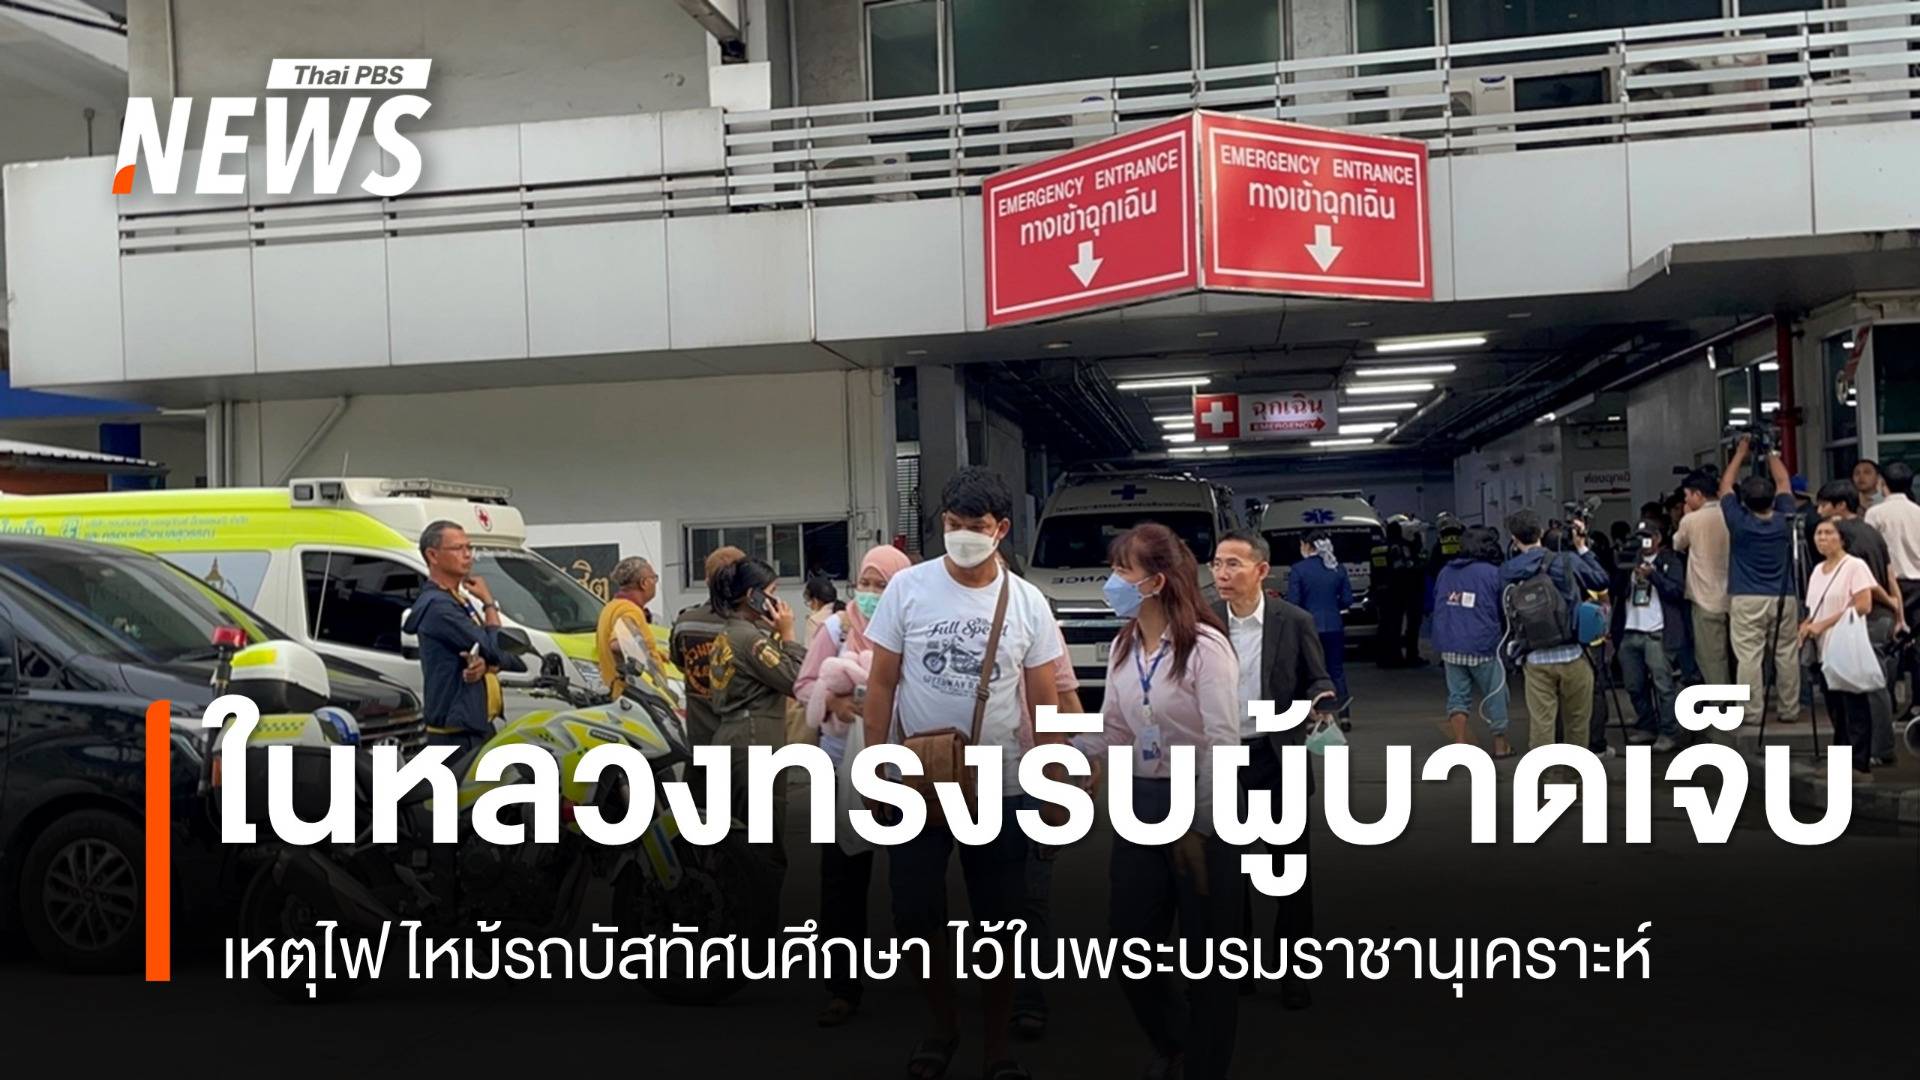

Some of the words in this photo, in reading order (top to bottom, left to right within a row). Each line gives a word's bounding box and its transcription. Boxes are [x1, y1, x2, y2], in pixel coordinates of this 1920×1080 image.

[998, 175, 1085, 217] EMERGENCY
[1094, 148, 1179, 190] ENTRANCE
[1219, 144, 1320, 175] EMERGENCY
[1332, 158, 1414, 186] ENTRANCE
[1020, 187, 1158, 246] ทางเข้าฉุกเฉิน
[1248, 179, 1396, 224] ทางเข้าฉุกเฉิน
[1252, 393, 1323, 421] ฉุกเฉิน
[929, 620, 960, 638] Full
